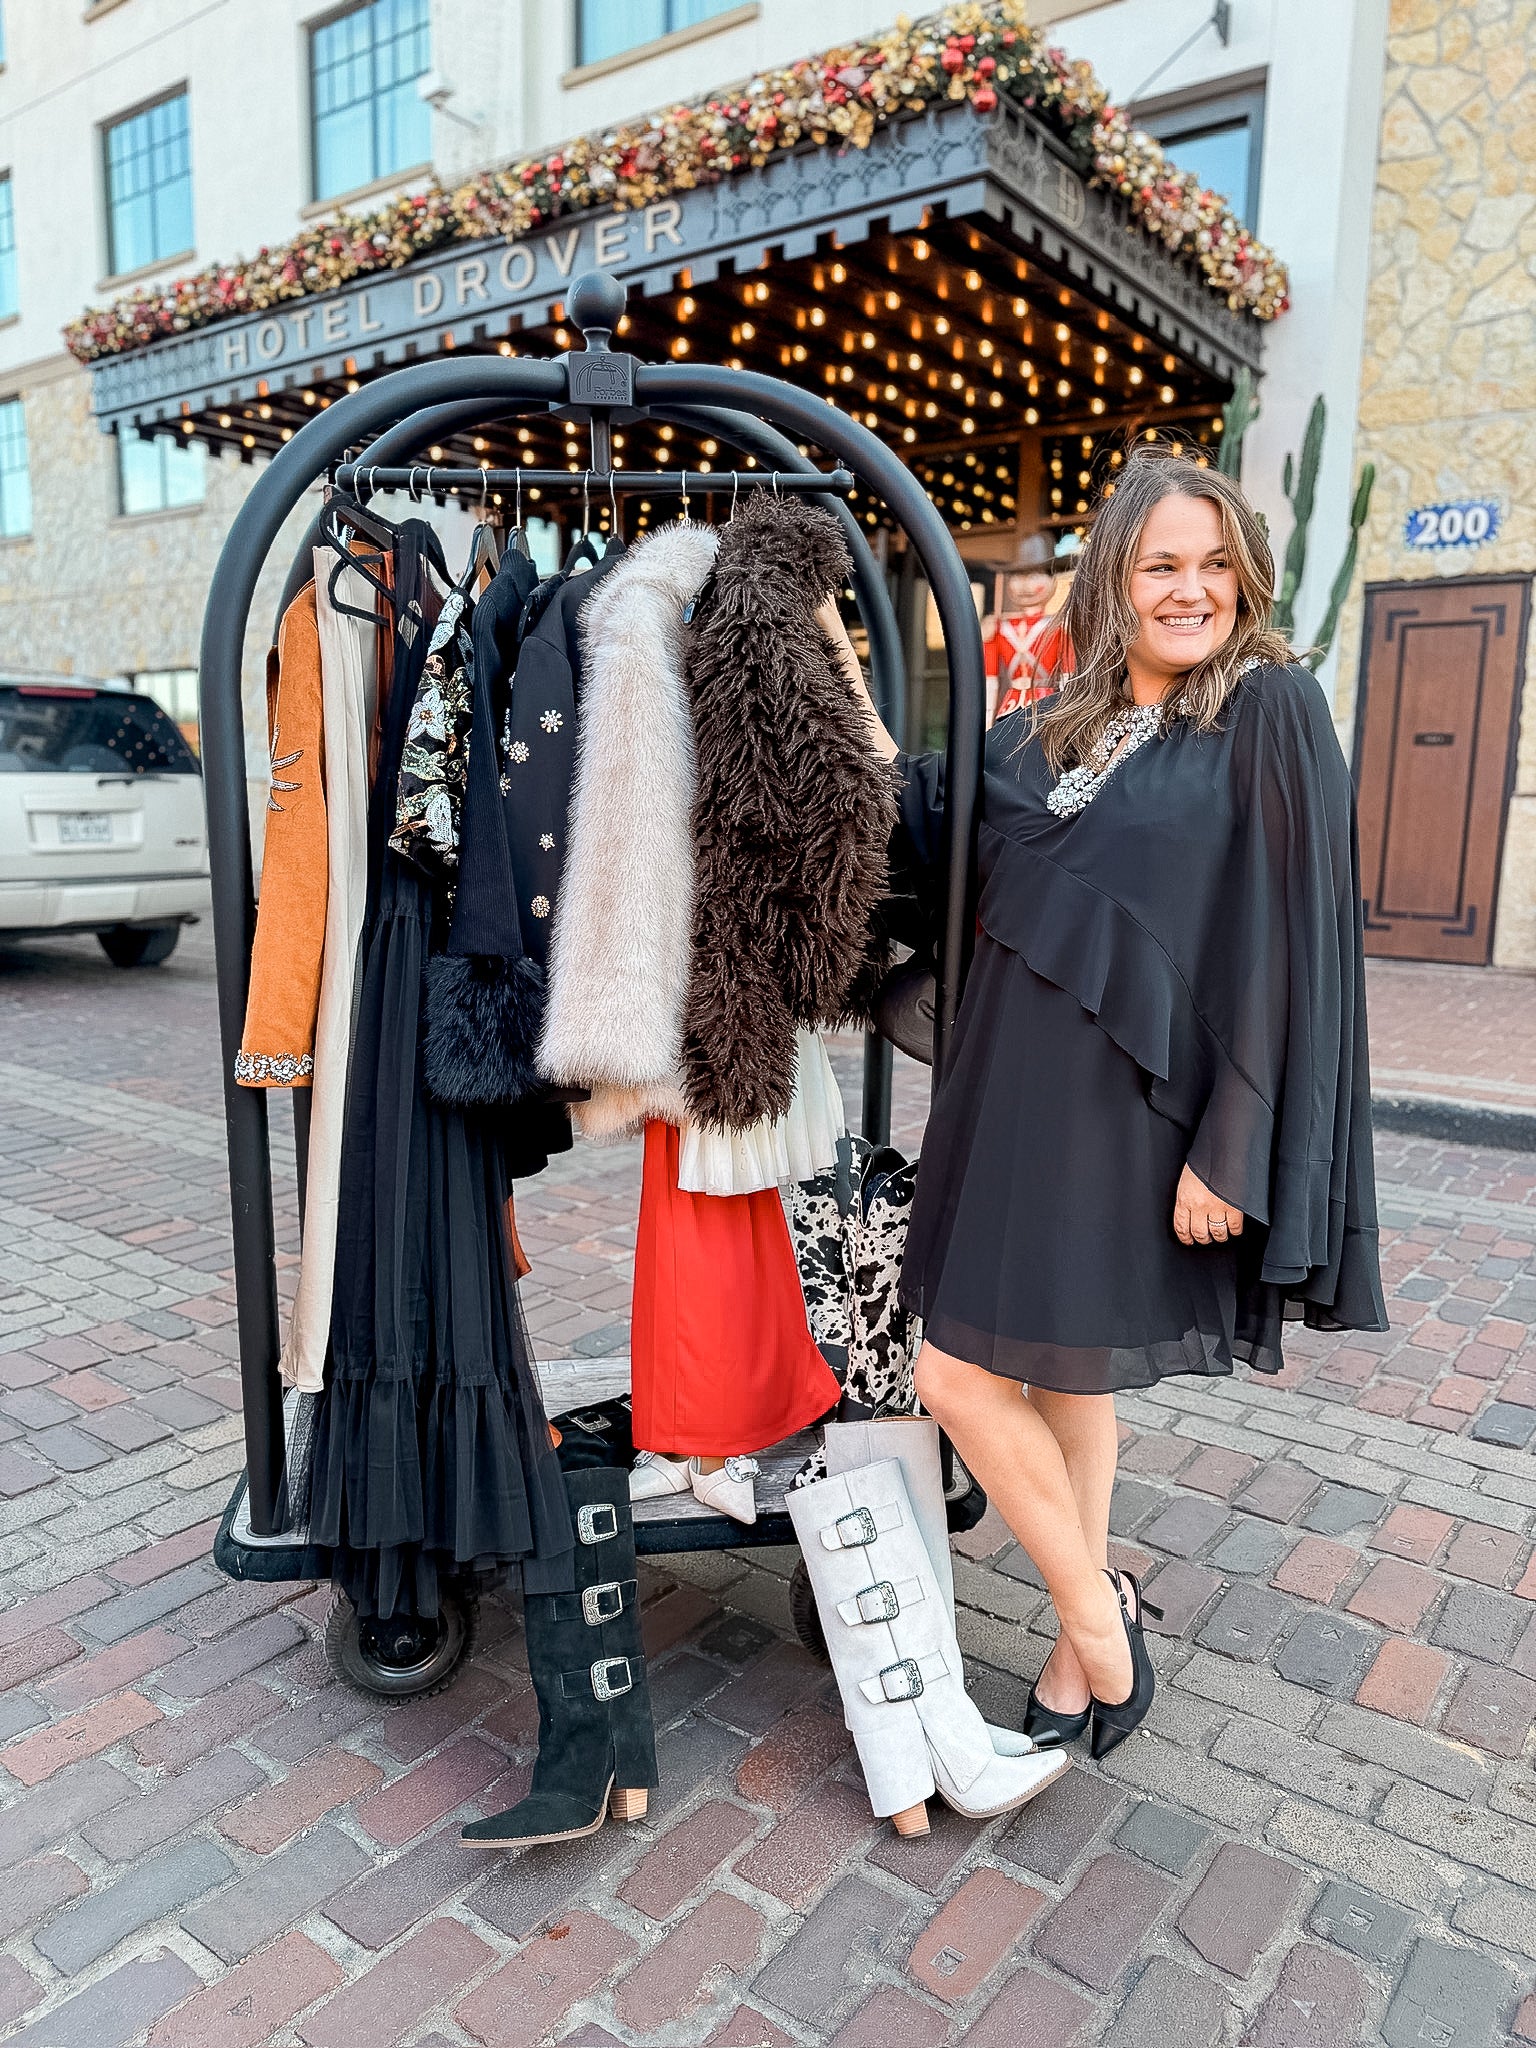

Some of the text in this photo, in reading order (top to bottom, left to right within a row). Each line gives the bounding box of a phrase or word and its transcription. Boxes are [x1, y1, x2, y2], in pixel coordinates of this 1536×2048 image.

[223, 199, 684, 370] HOTEL DROVER
[1414, 507, 1490, 546] 200
